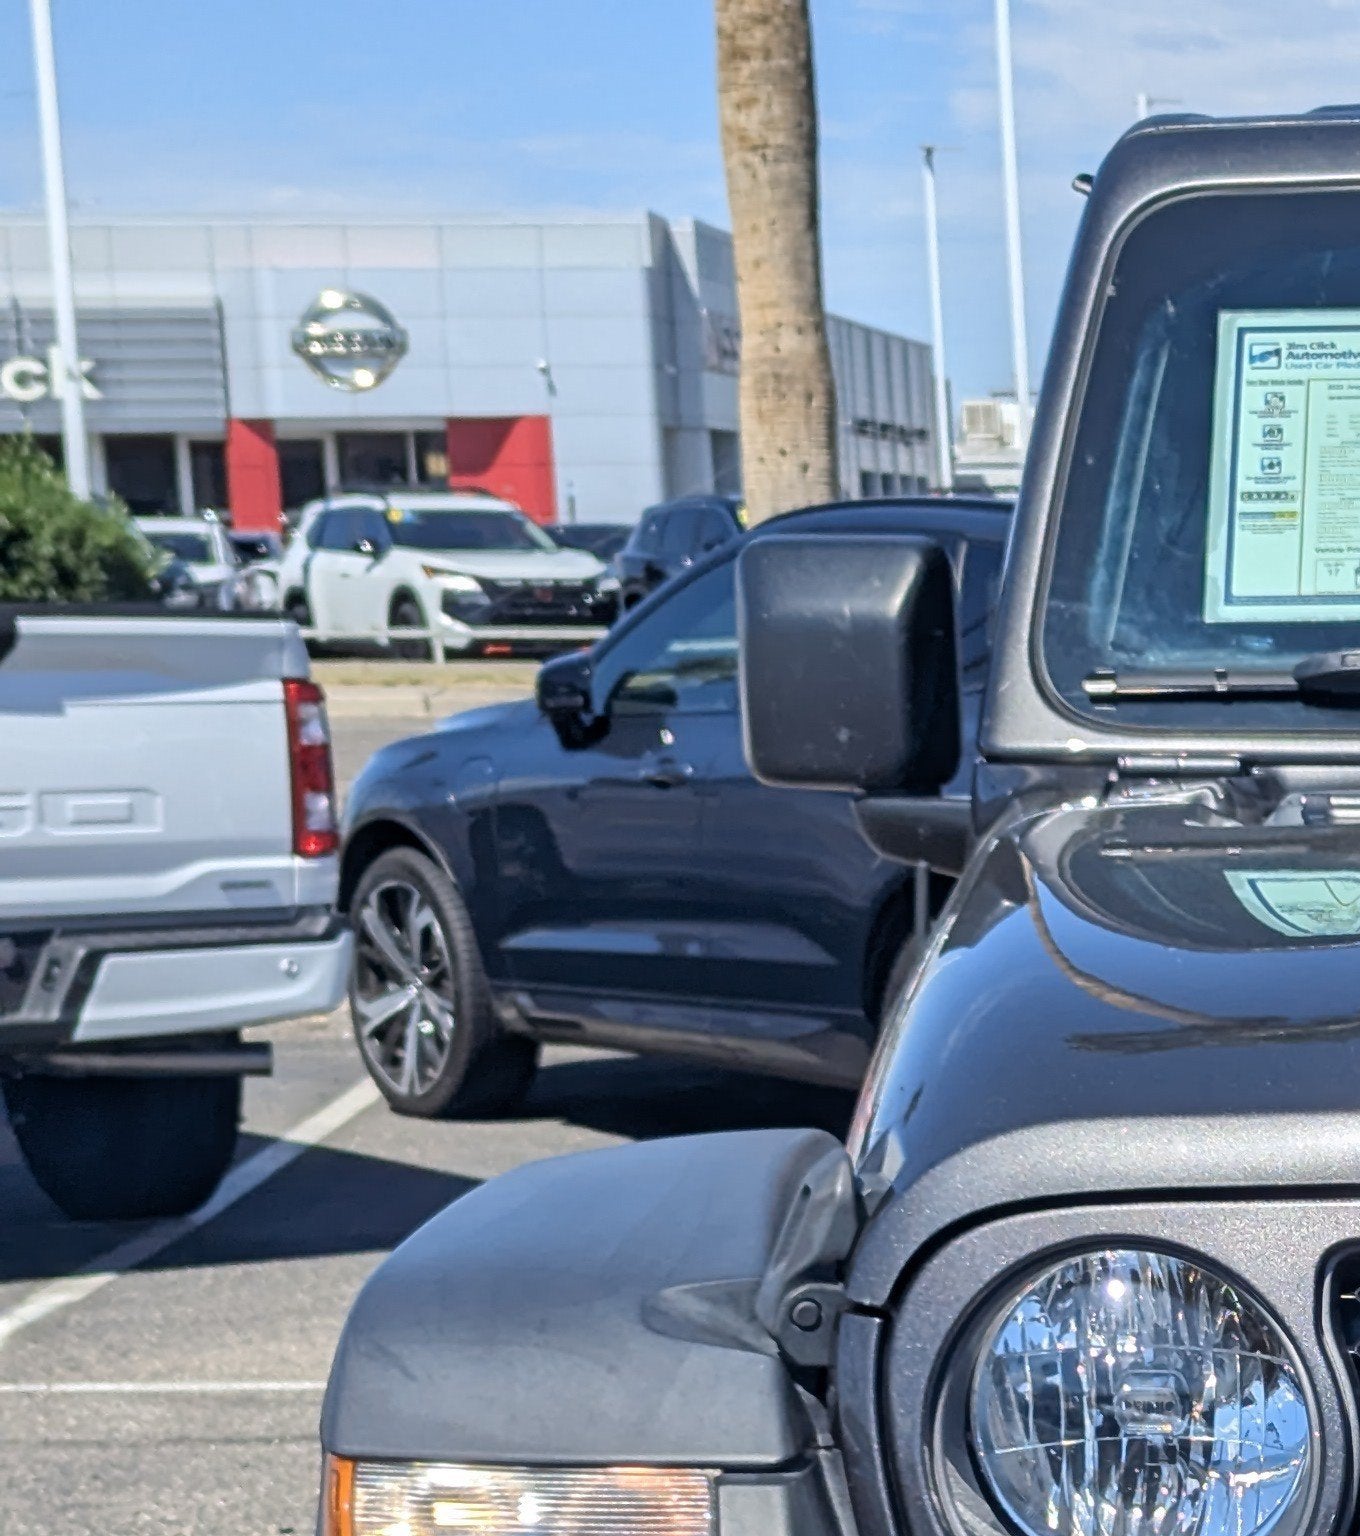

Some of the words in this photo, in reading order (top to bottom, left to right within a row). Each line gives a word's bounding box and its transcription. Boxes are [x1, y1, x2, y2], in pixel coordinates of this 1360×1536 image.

[1309, 342, 1337, 350] Click
[1285, 362, 1312, 370] Used
[1315, 362, 1333, 370] Car
